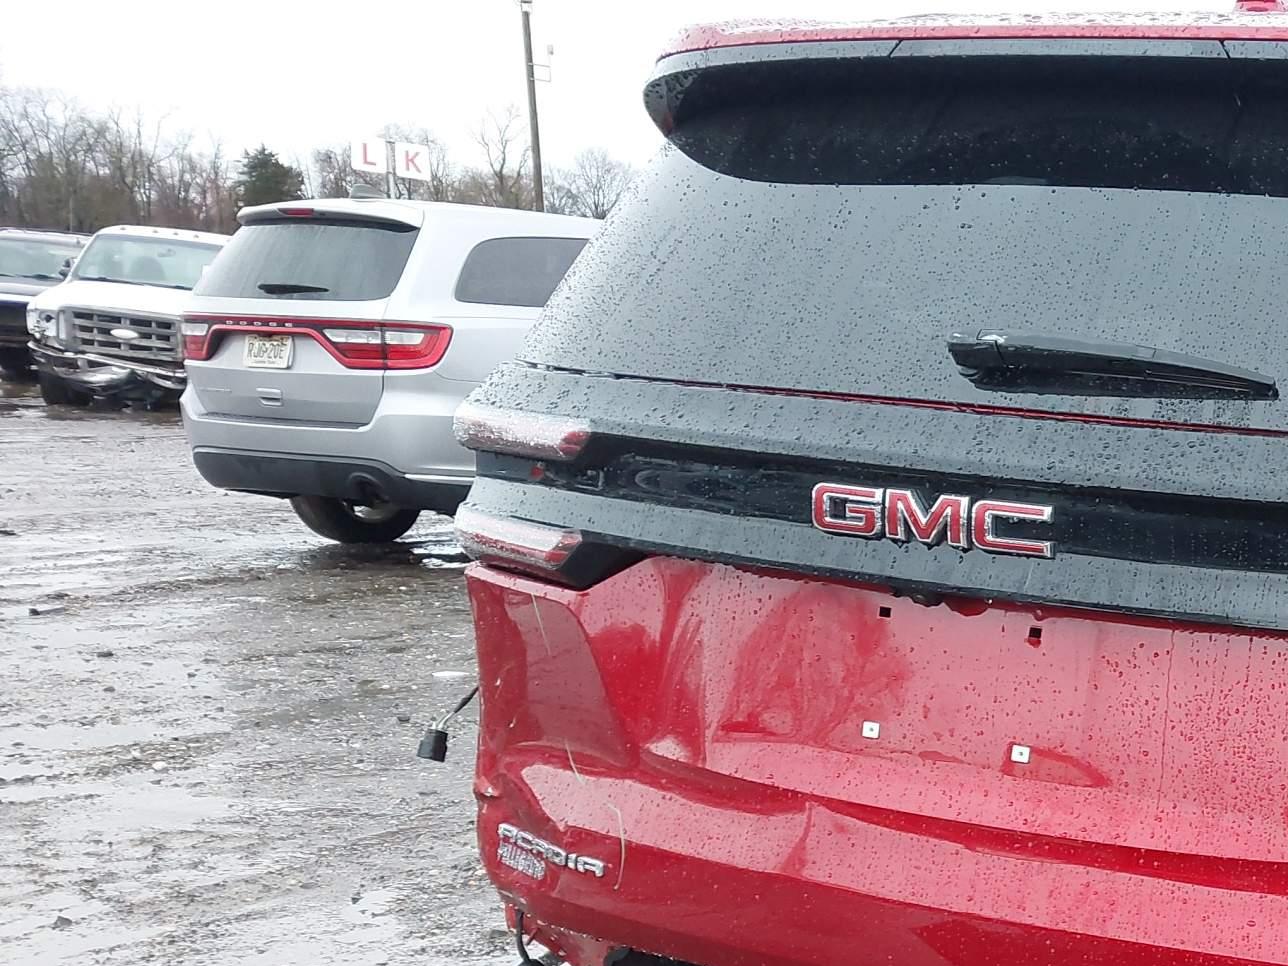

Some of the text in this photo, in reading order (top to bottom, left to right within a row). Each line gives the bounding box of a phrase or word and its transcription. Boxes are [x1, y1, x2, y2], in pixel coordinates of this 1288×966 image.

[362, 143, 377, 166] L
[405, 150, 421, 173] K
[811, 482, 1054, 557] GMC
[497, 823, 605, 877] ACADIA
